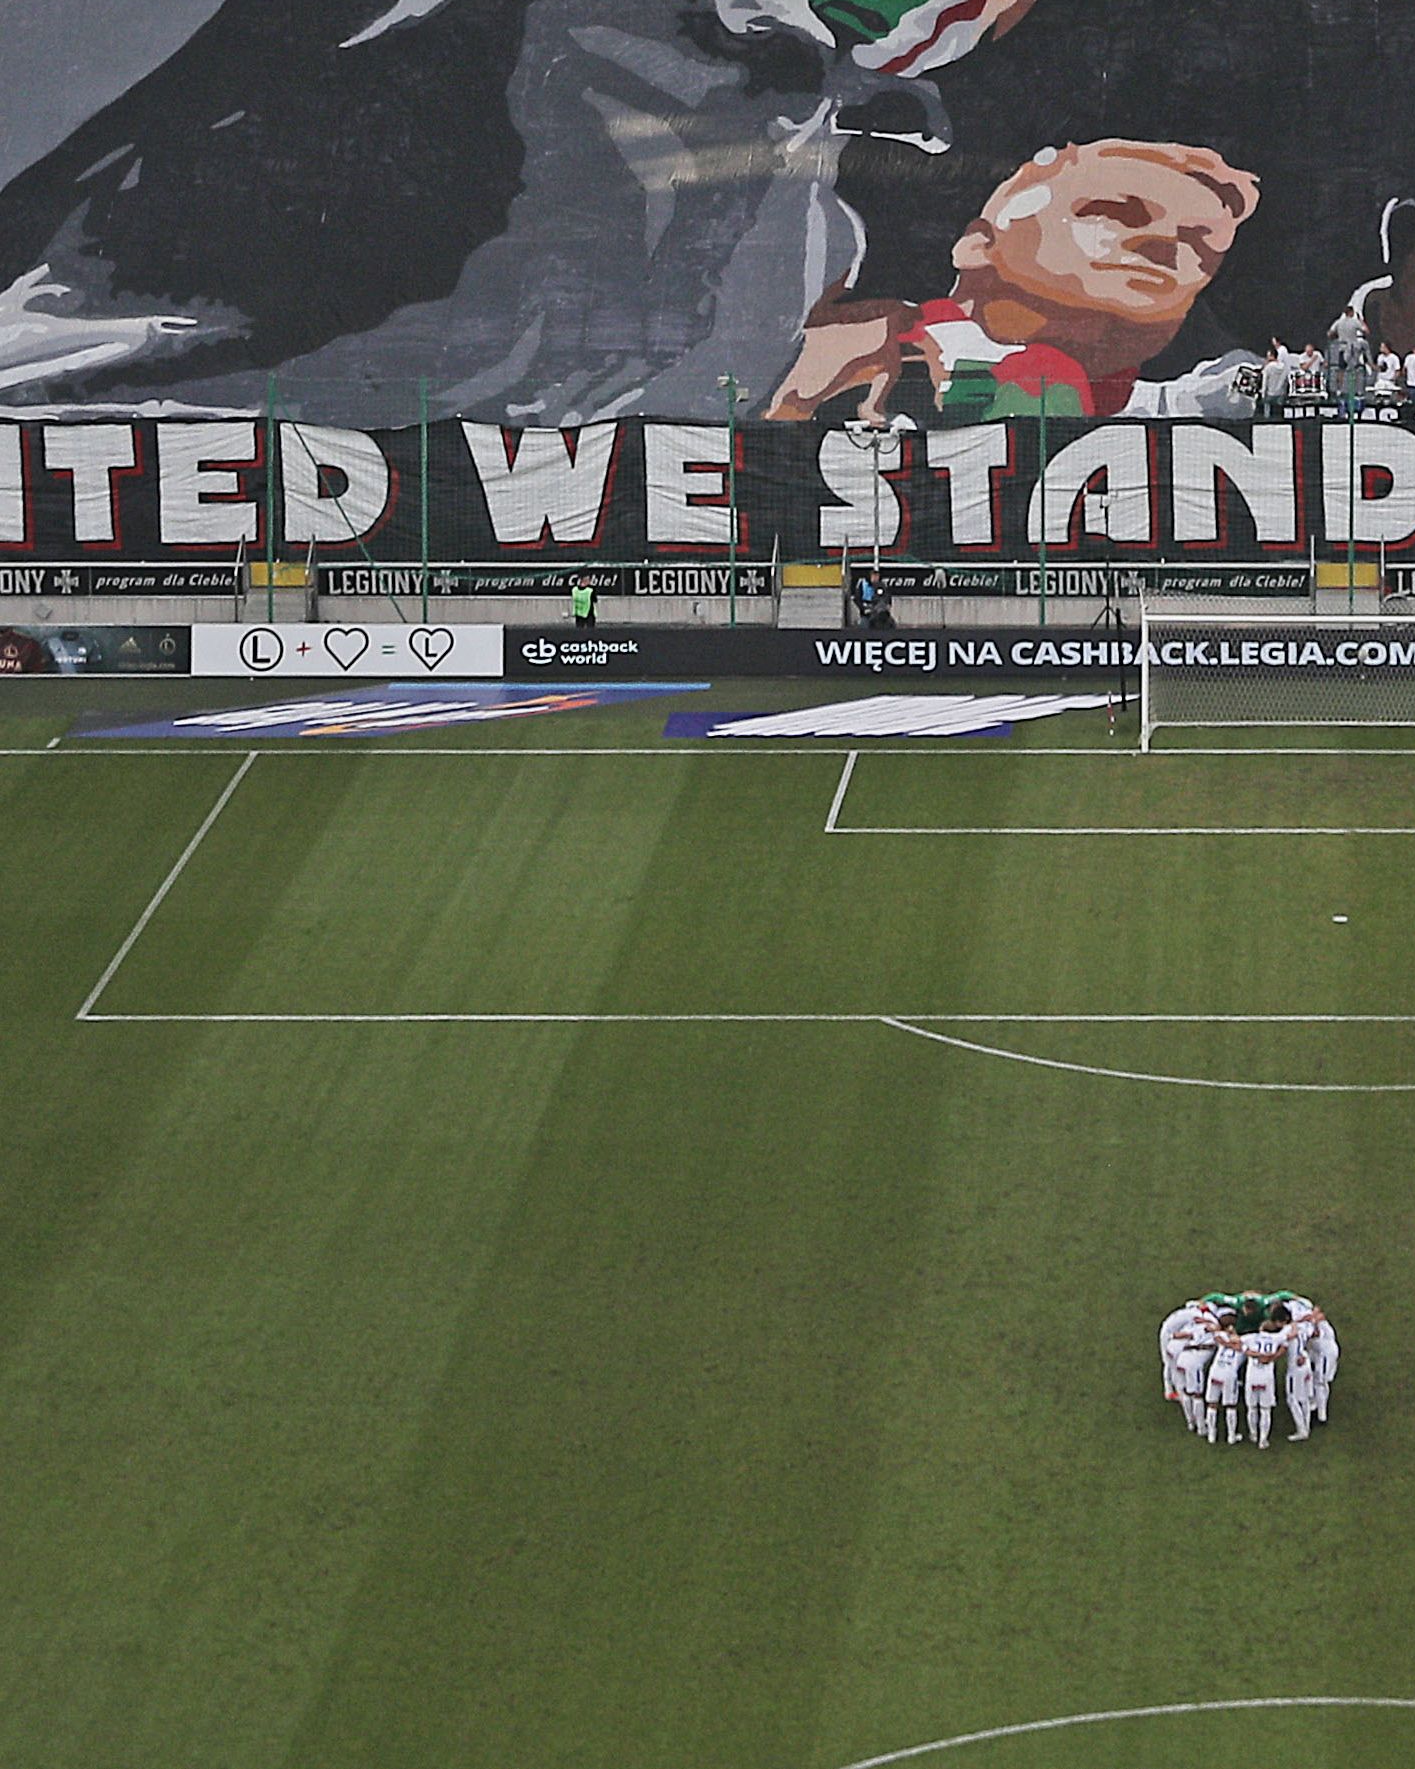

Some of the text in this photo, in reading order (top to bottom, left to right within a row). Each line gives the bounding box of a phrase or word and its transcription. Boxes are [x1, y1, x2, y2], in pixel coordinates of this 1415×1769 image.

[462, 422, 739, 545] WE
[96, 574, 156, 590] program
[163, 573, 185, 587] dla
[328, 570, 428, 595] LEGIONY
[475, 574, 535, 591] program
[542, 573, 564, 587] dla
[635, 570, 732, 595] LEGIONY
[1016, 570, 1110, 596] LEGIONY
[1162, 576, 1222, 592] program
[1229, 575, 1251, 589] dla
[560, 640, 639, 653] cashback
[815, 641, 940, 672] WIĘCEJ
[948, 641, 1003, 666] NA
[560, 653, 607, 665] world
